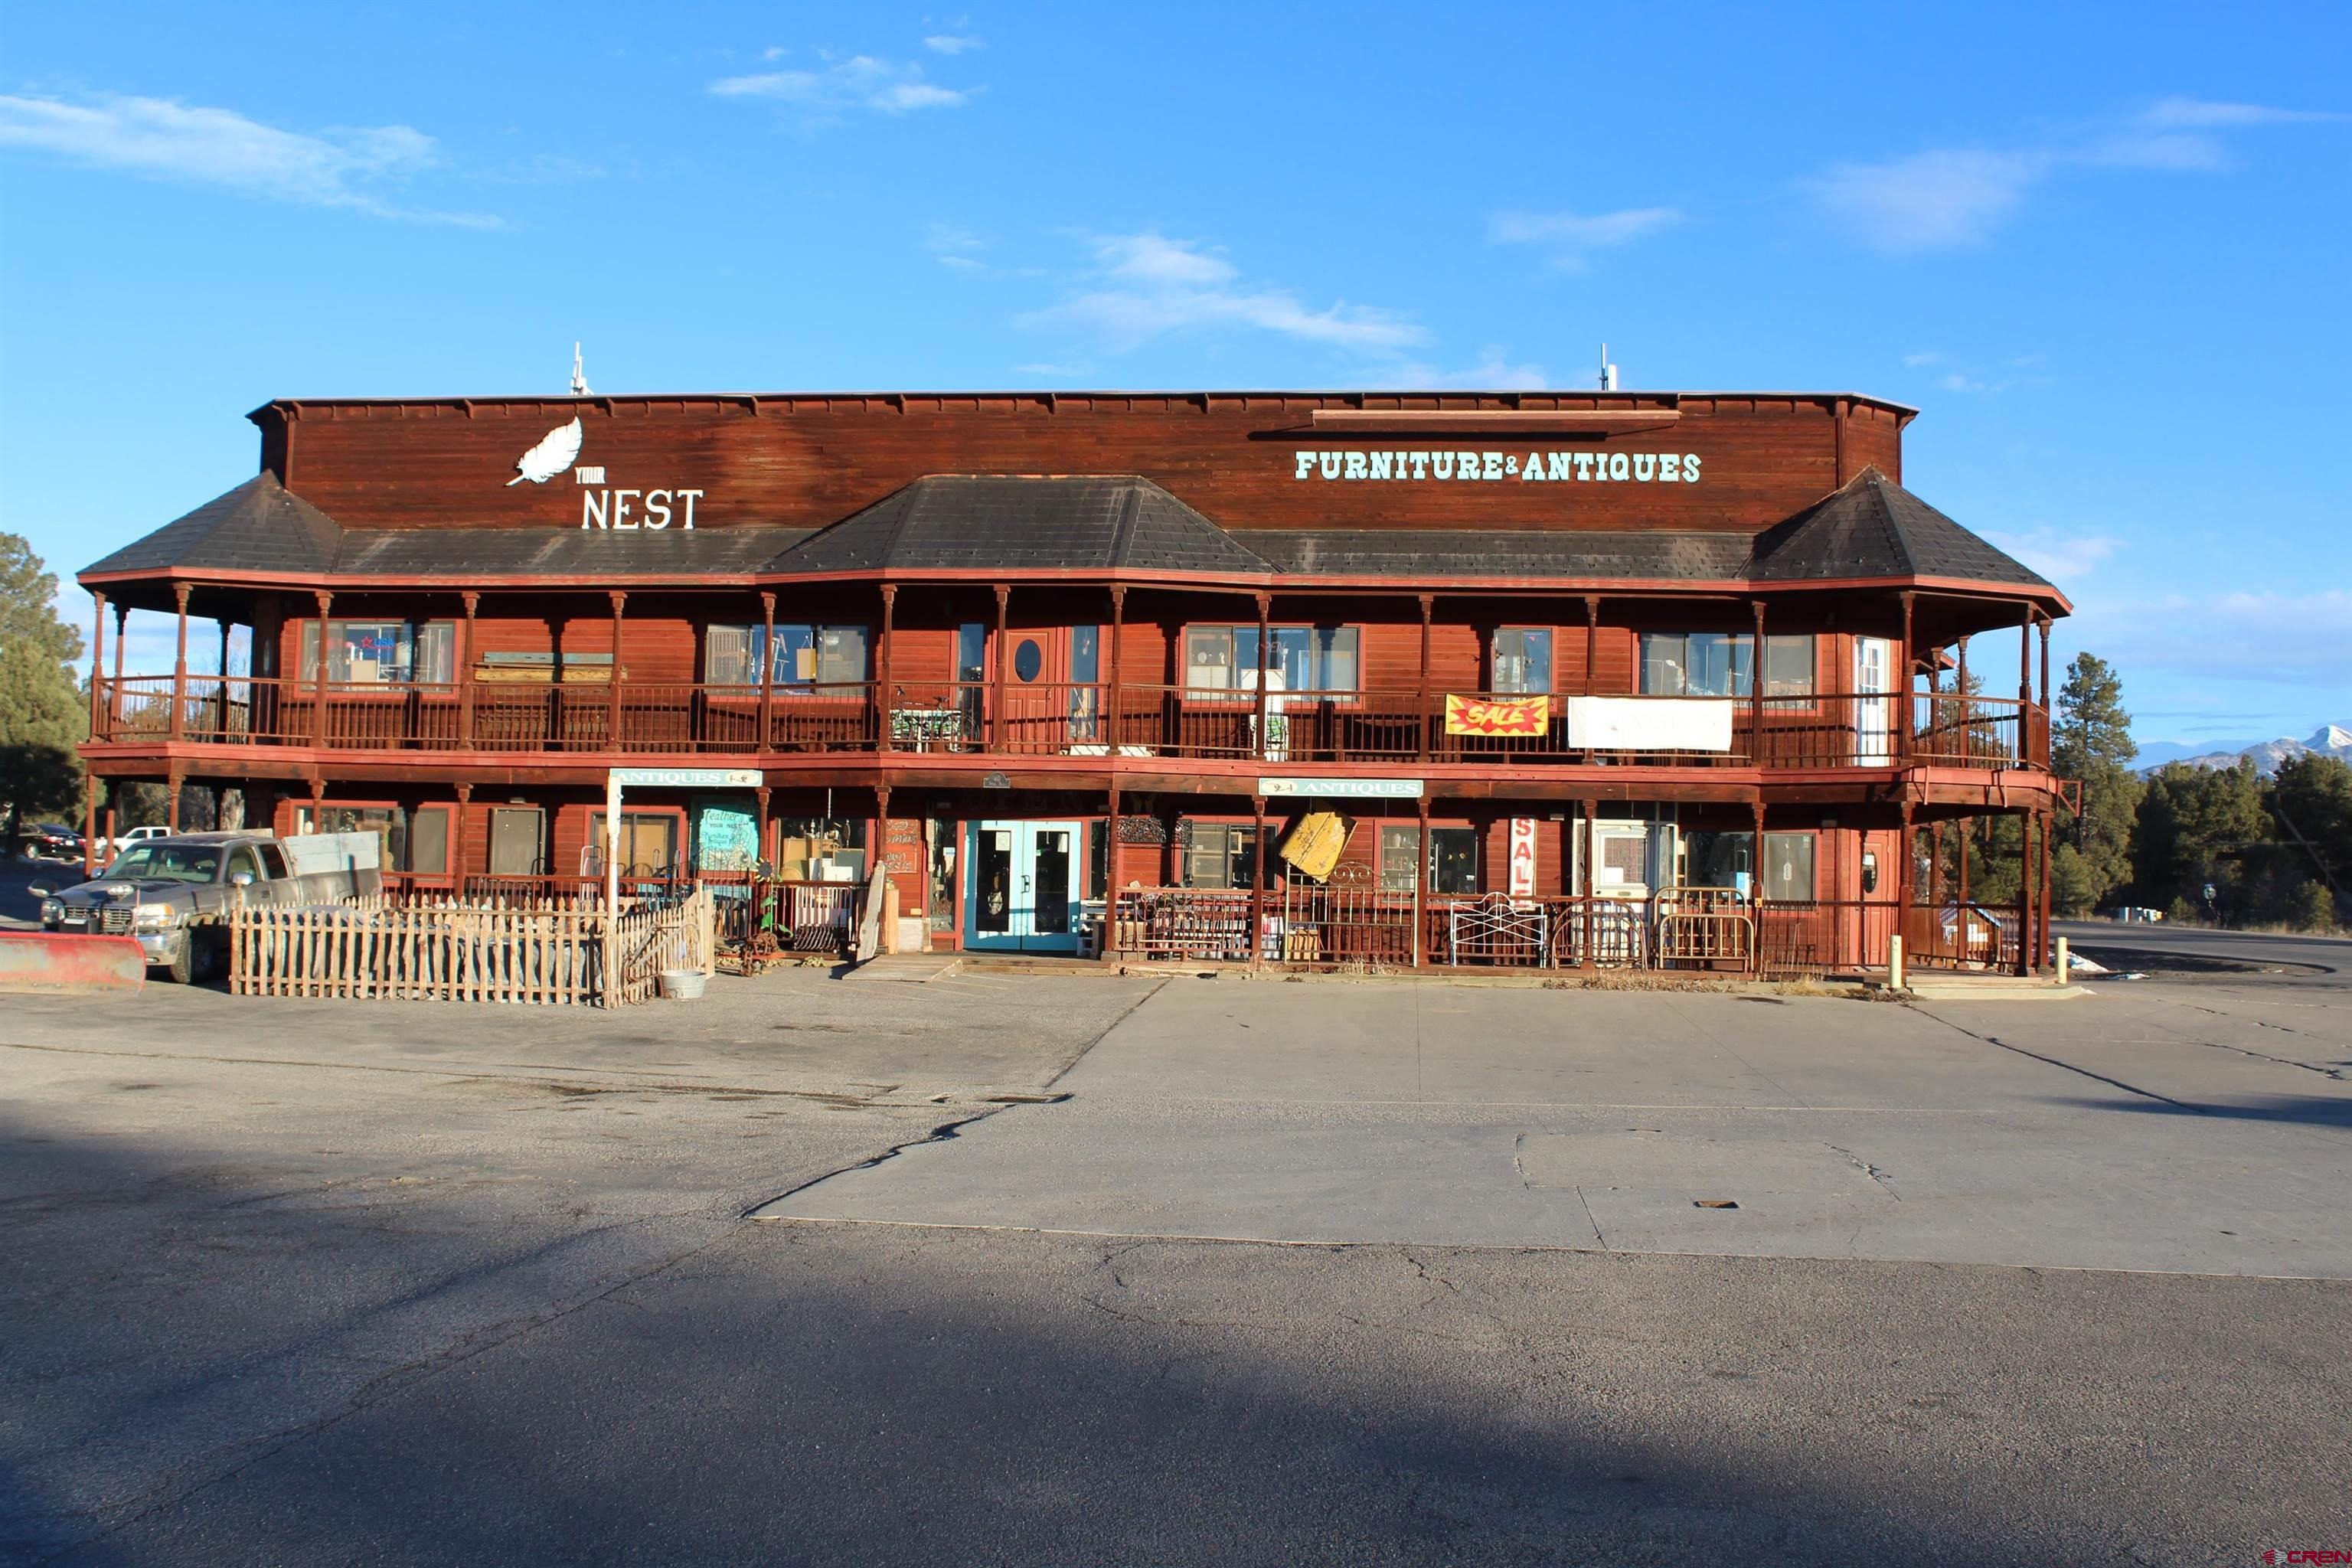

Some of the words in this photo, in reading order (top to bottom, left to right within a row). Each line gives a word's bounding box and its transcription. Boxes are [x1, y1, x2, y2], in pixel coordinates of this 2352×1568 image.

[574, 466, 606, 484] YOUR
[1295, 451, 1503, 480] FURNITURE
[1521, 452, 1701, 483] ANTIQUES
[581, 489, 704, 529] NEST
[374, 637, 394, 647] USA
[1465, 705, 1528, 727] SALE
[617, 772, 721, 786] ANTIQUES
[1303, 782, 1418, 796] ANTIQUES
[1514, 817, 1531, 908] SALE
